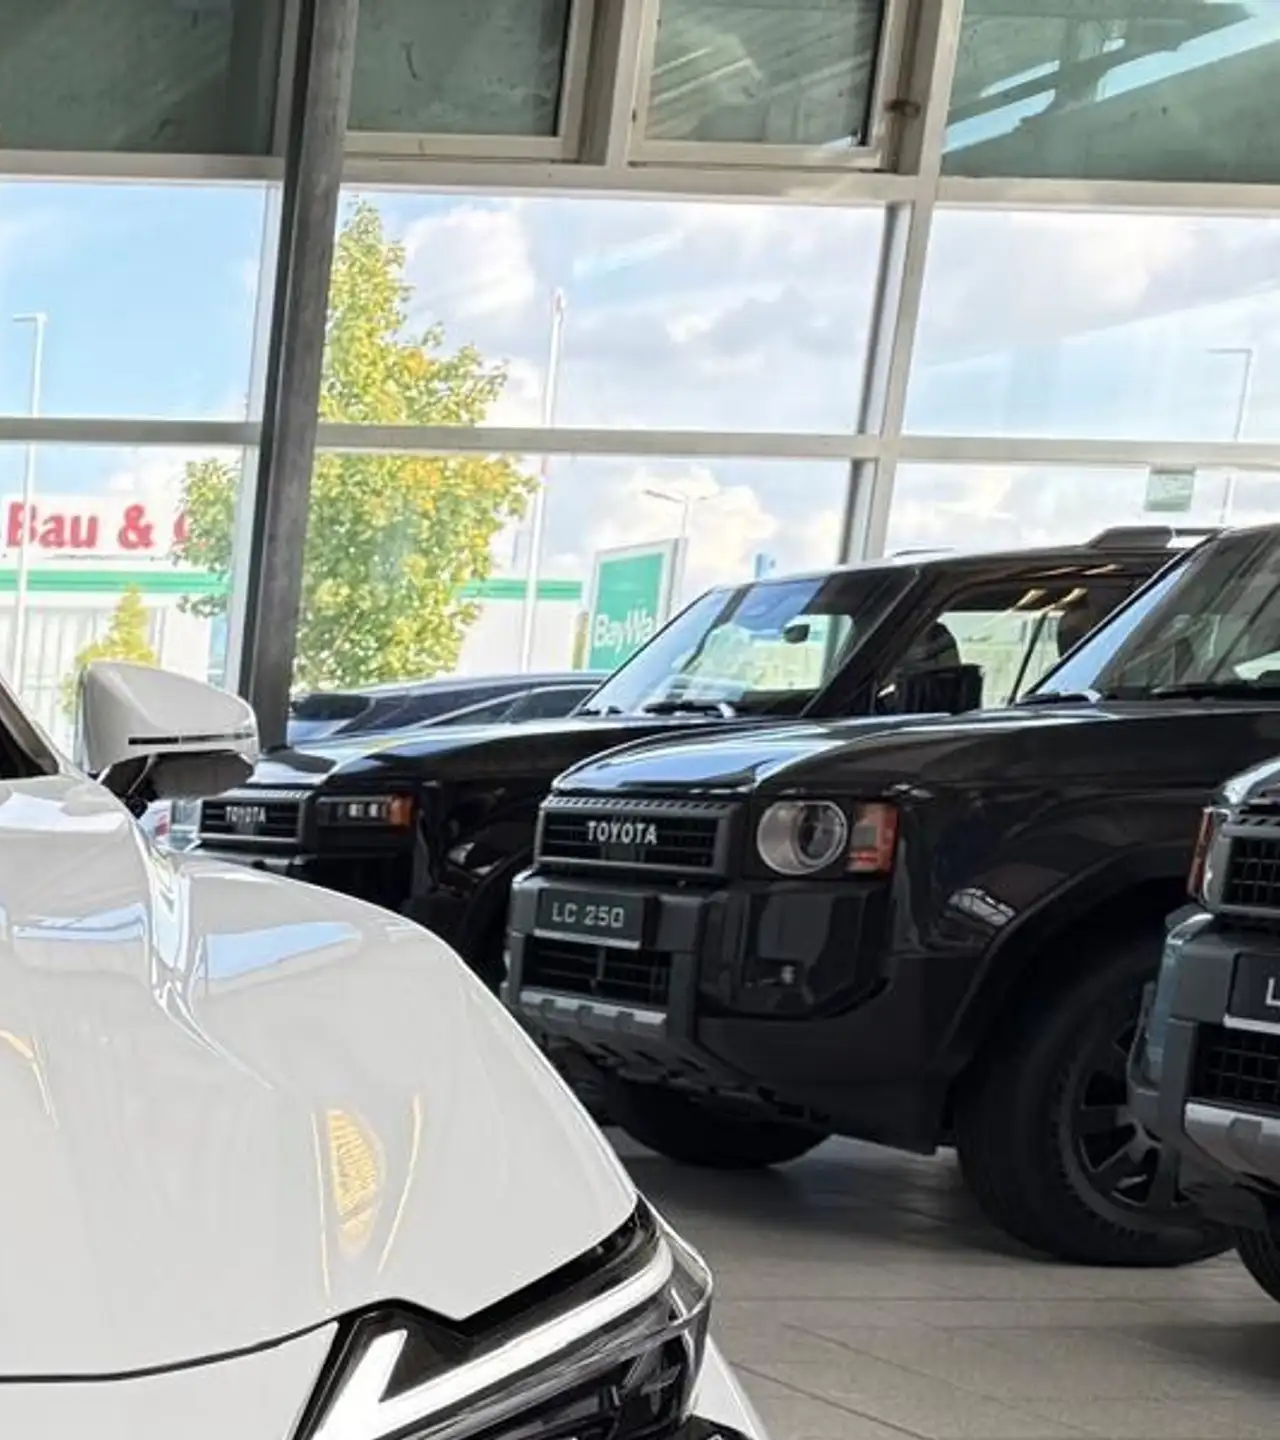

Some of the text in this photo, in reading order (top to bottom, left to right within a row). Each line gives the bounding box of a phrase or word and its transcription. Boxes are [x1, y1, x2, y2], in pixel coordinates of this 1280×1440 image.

[6, 501, 99, 549] Bau
[118, 503, 155, 550] &
[225, 805, 267, 824] TOYOTA
[587, 820, 658, 846] TOYOTA
[552, 901, 625, 929] LC 250
